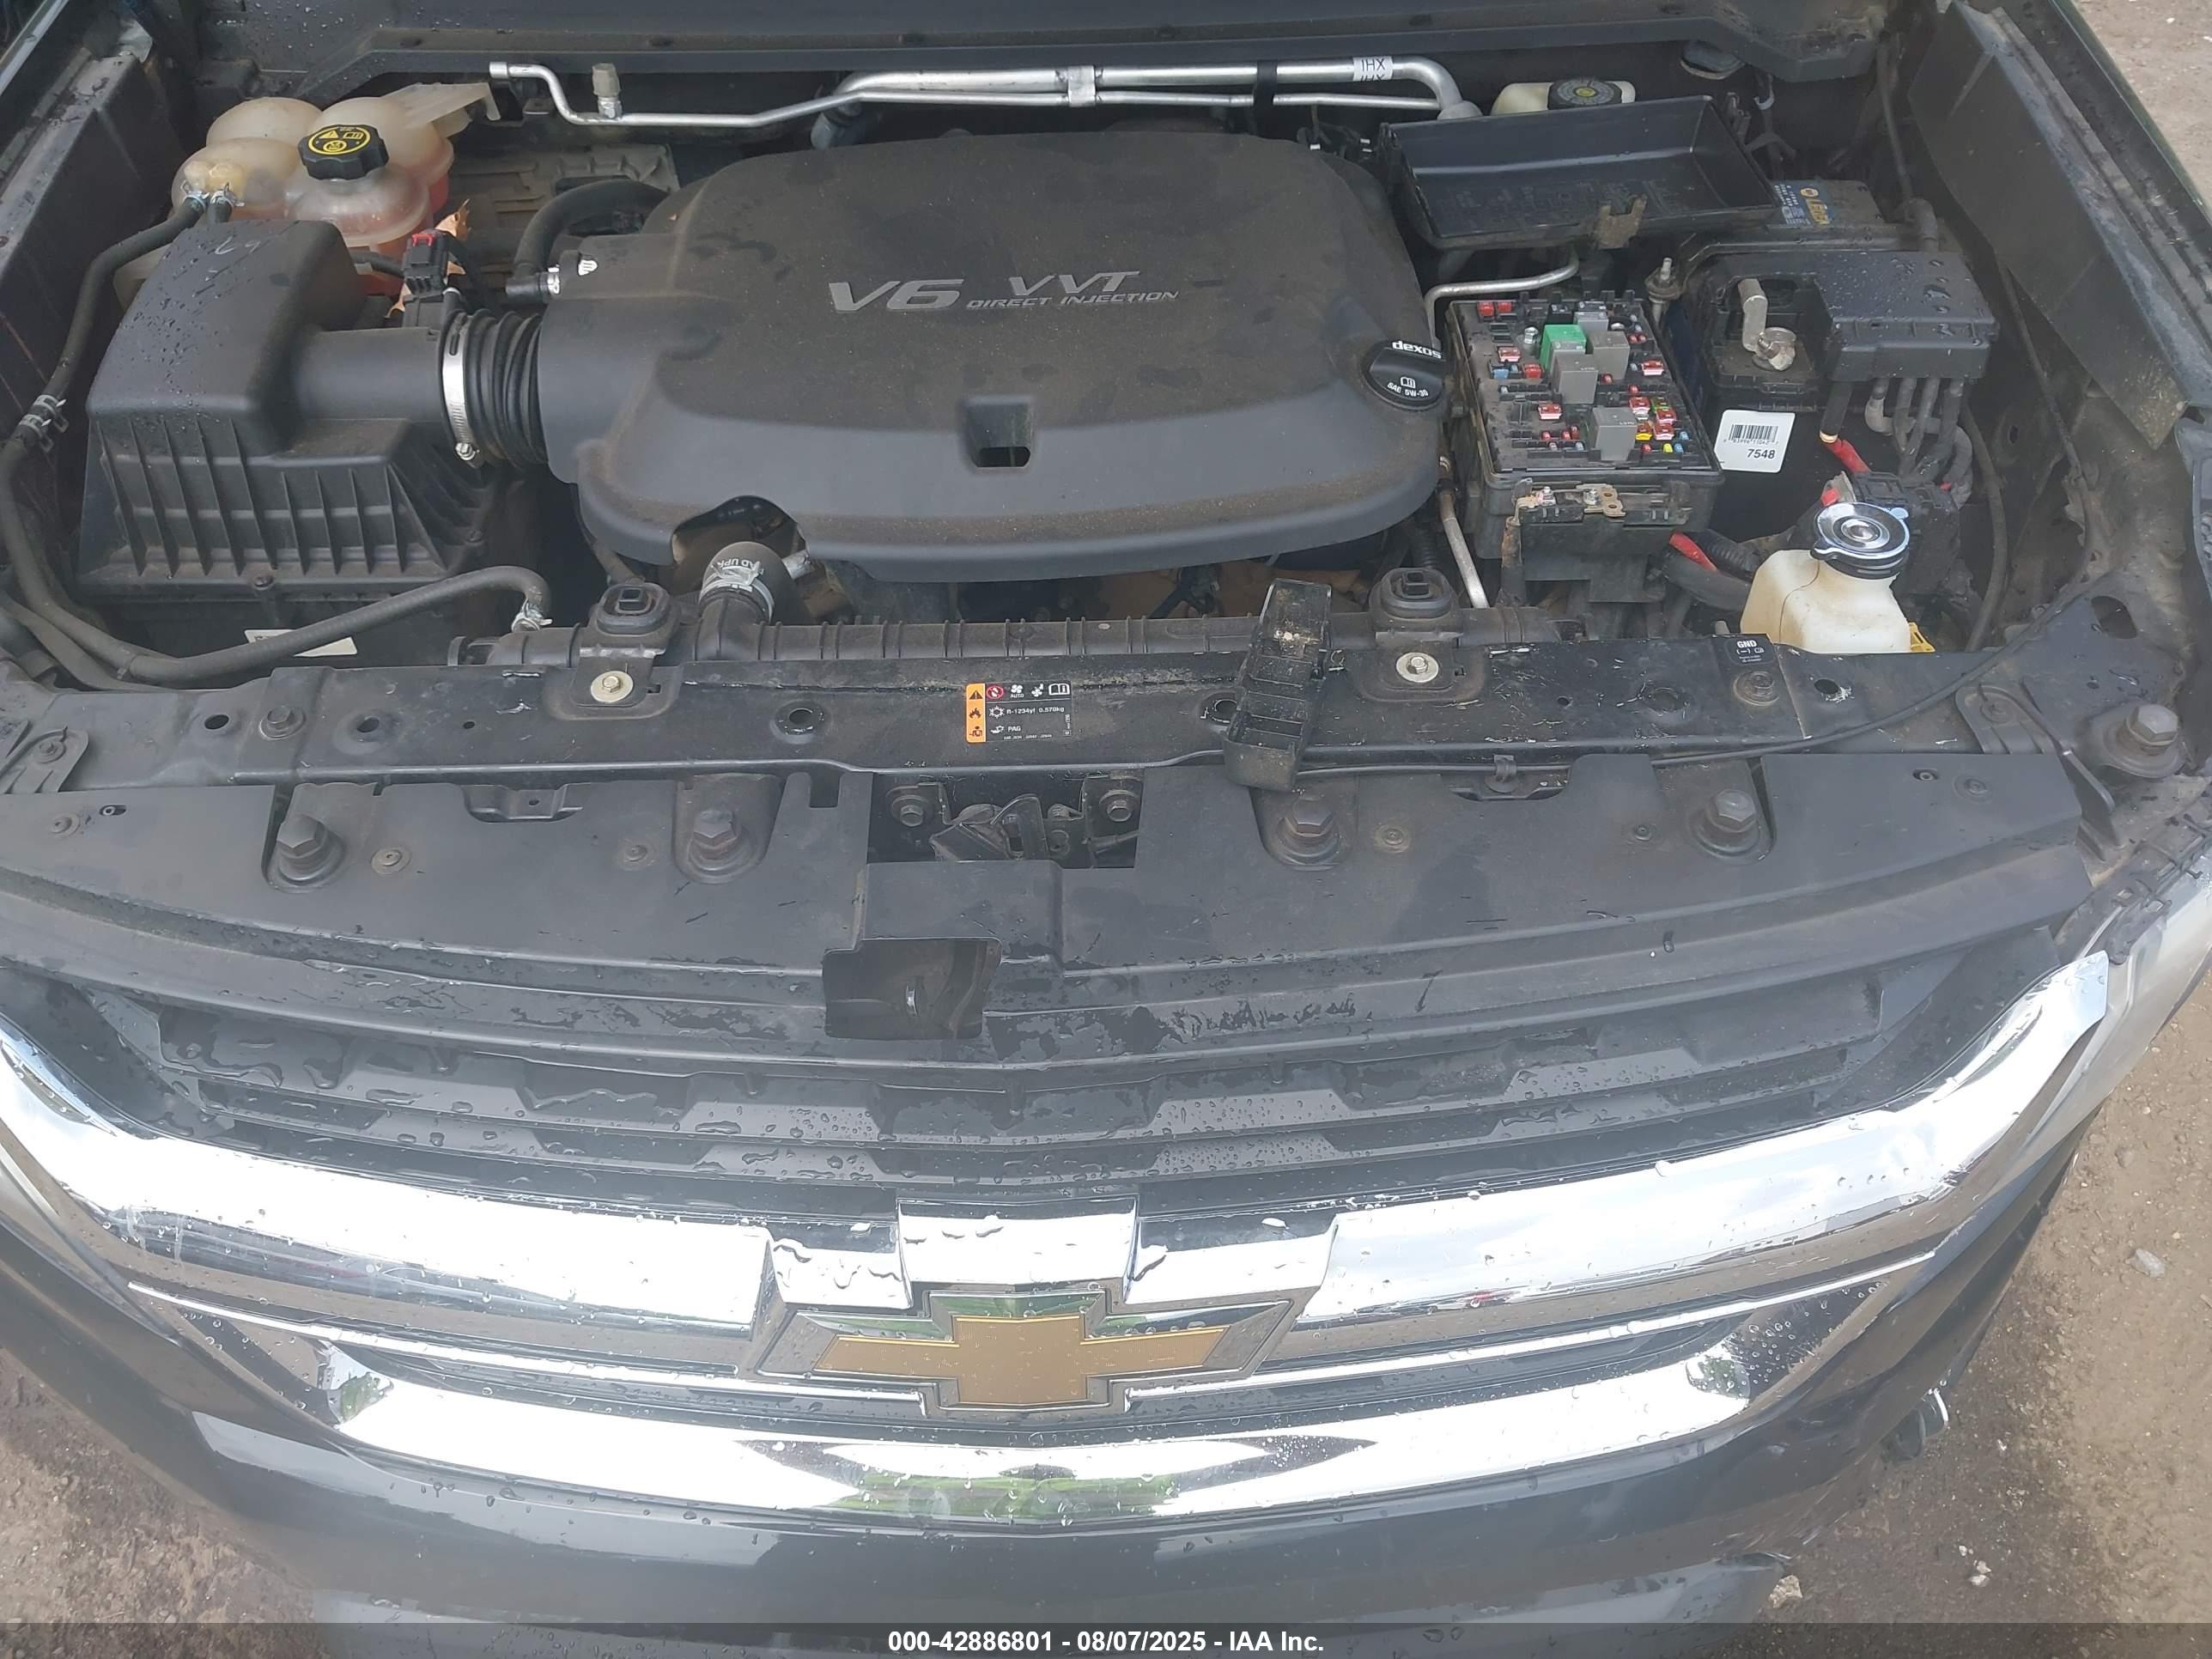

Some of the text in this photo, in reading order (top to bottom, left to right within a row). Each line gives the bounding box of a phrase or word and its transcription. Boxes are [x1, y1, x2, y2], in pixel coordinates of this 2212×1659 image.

[829, 270, 1140, 312] V6 VVT
[966, 290, 1179, 309] DIRECT INJECTION
[1392, 340, 1442, 359] dexos
[1387, 382, 1402, 393] SAE
[1747, 448, 1776, 459] 7548
[1737, 640, 1757, 648] GND
